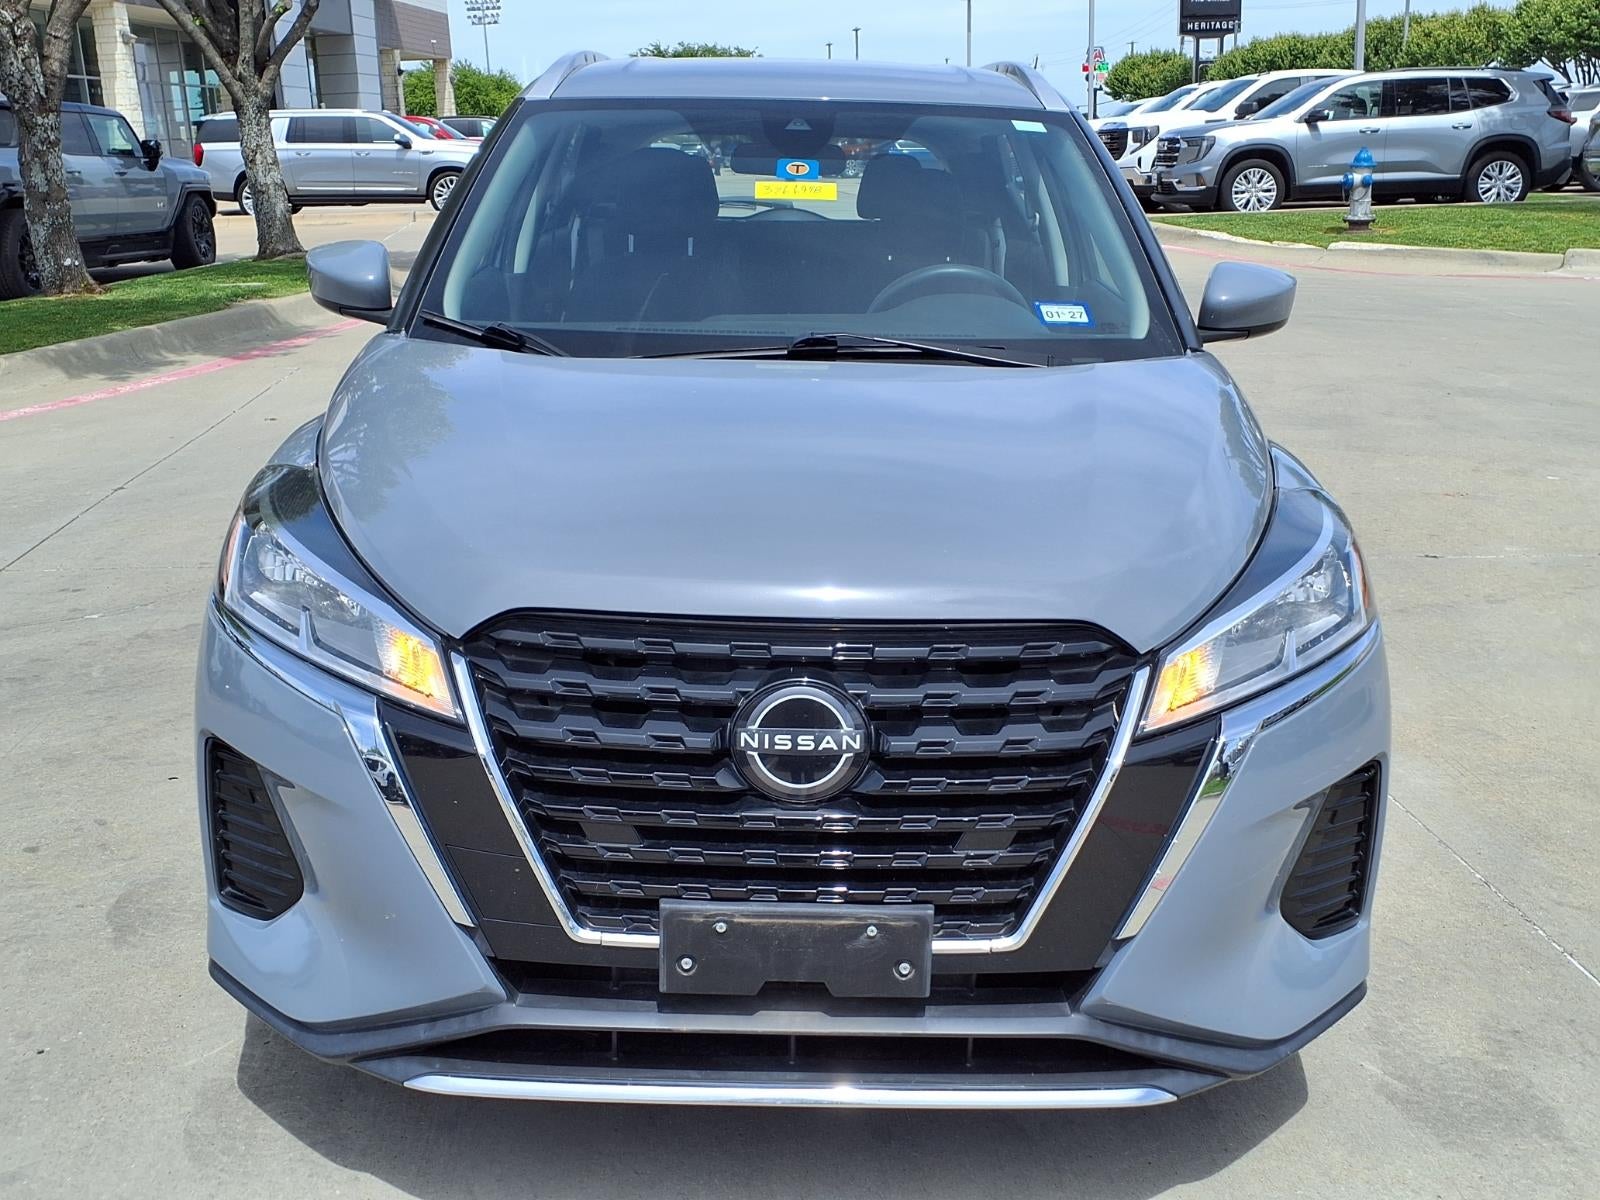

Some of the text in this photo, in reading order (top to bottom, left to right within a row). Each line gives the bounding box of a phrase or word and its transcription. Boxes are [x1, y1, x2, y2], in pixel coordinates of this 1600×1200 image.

[1187, 20, 1234, 31] HERITAGE
[791, 164, 805, 174] T
[1045, 310, 1084, 319] 01 27
[740, 731, 861, 751] NISSAN
